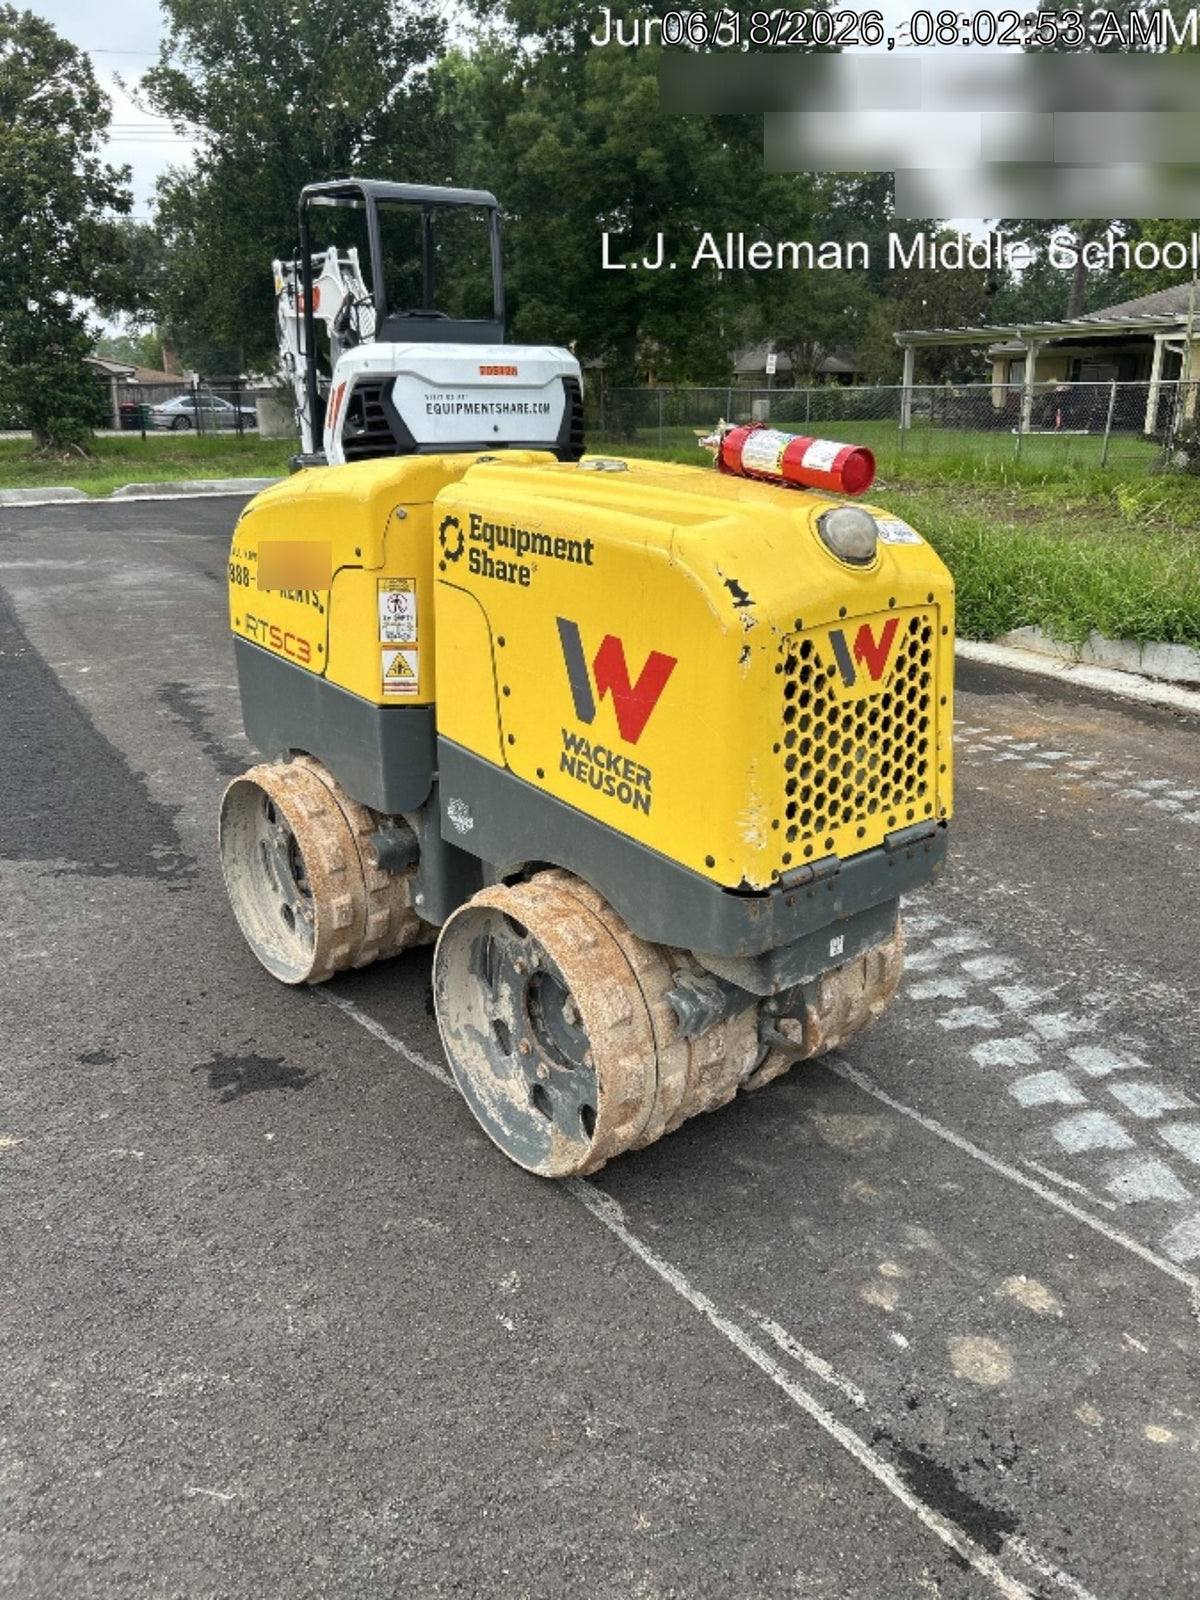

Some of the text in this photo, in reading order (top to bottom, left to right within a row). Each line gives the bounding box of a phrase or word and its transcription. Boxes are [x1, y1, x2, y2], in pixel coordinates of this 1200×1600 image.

[426, 402, 550, 415] EQUIPMENTSHARE.COM
[469, 513, 595, 566] Equipment
[469, 547, 531, 587] Share
[560, 751, 652, 816] NEUSON
[561, 728, 652, 792] WACKER
